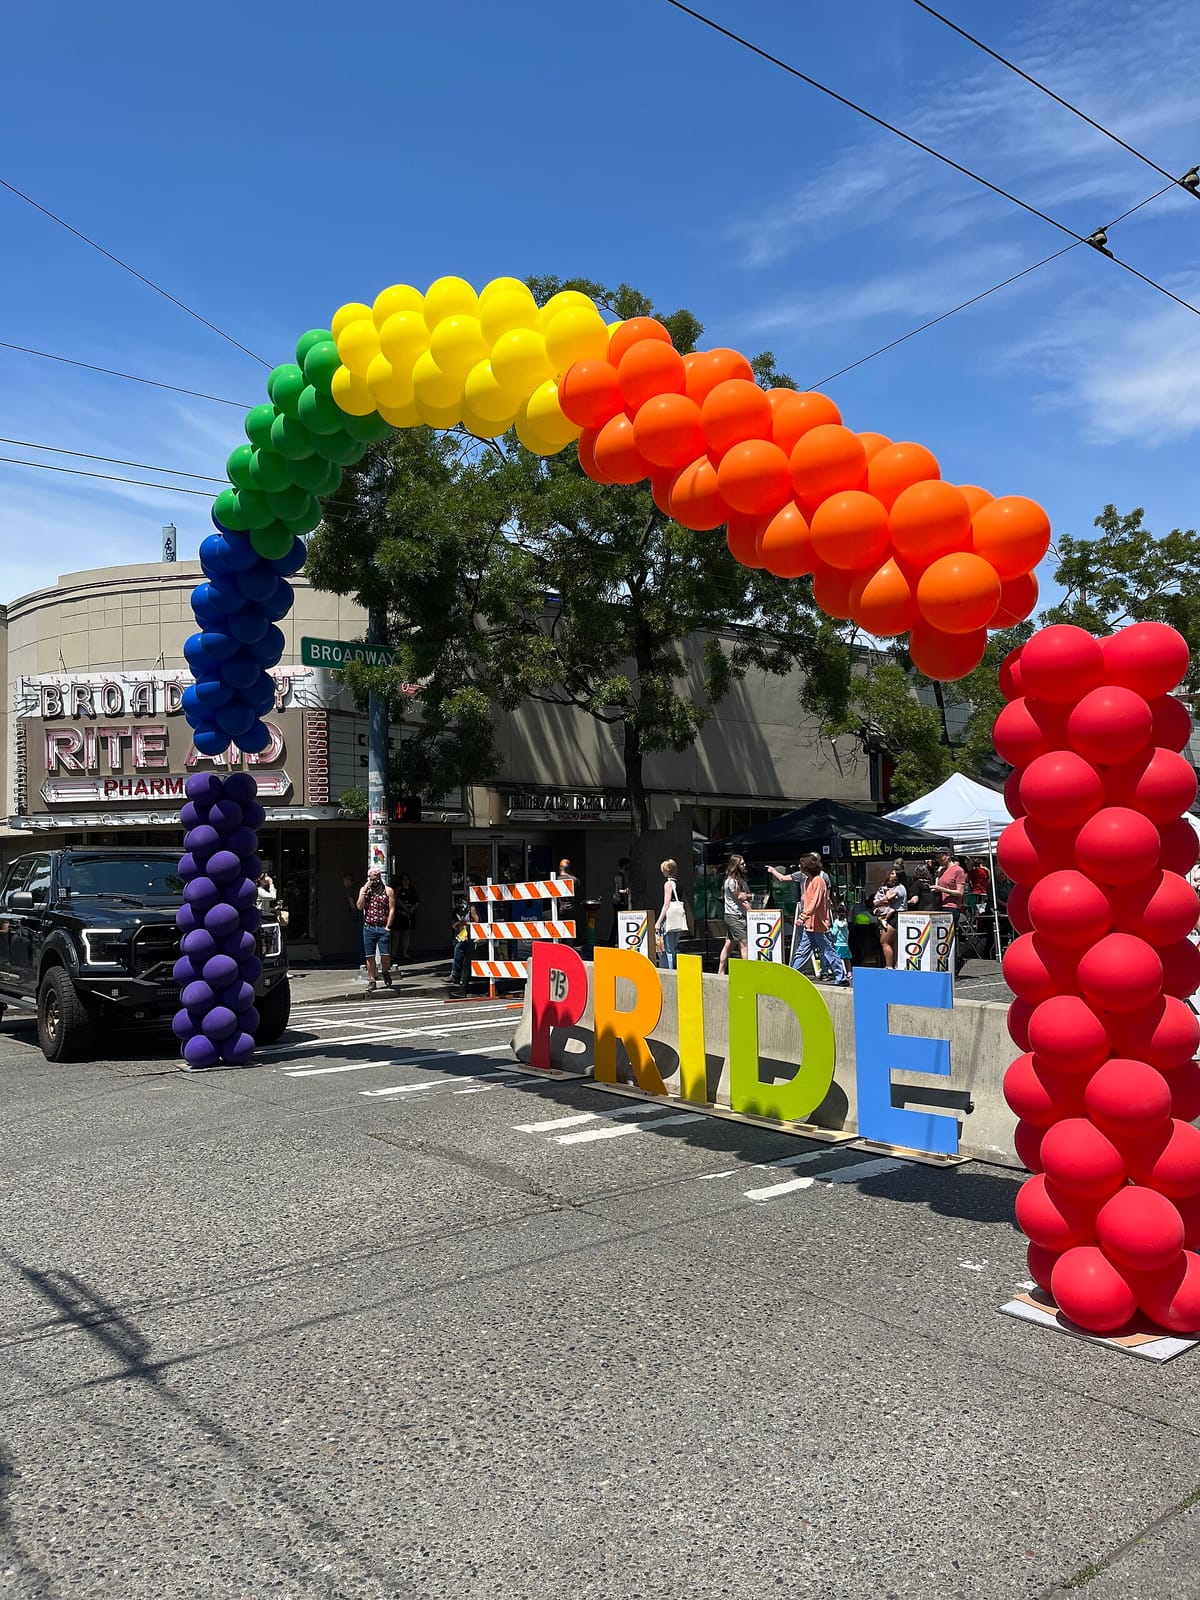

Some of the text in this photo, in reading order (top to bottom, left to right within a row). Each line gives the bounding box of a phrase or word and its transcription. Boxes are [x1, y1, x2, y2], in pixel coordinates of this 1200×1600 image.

[310, 644, 396, 667] BROADWAY
[41, 678, 291, 717] BROADY
[45, 725, 168, 771] RITE
[104, 778, 184, 797] PHARM
[850, 839, 941, 857] LINK by Superpedestria
[532, 941, 958, 1154] PRIDE
